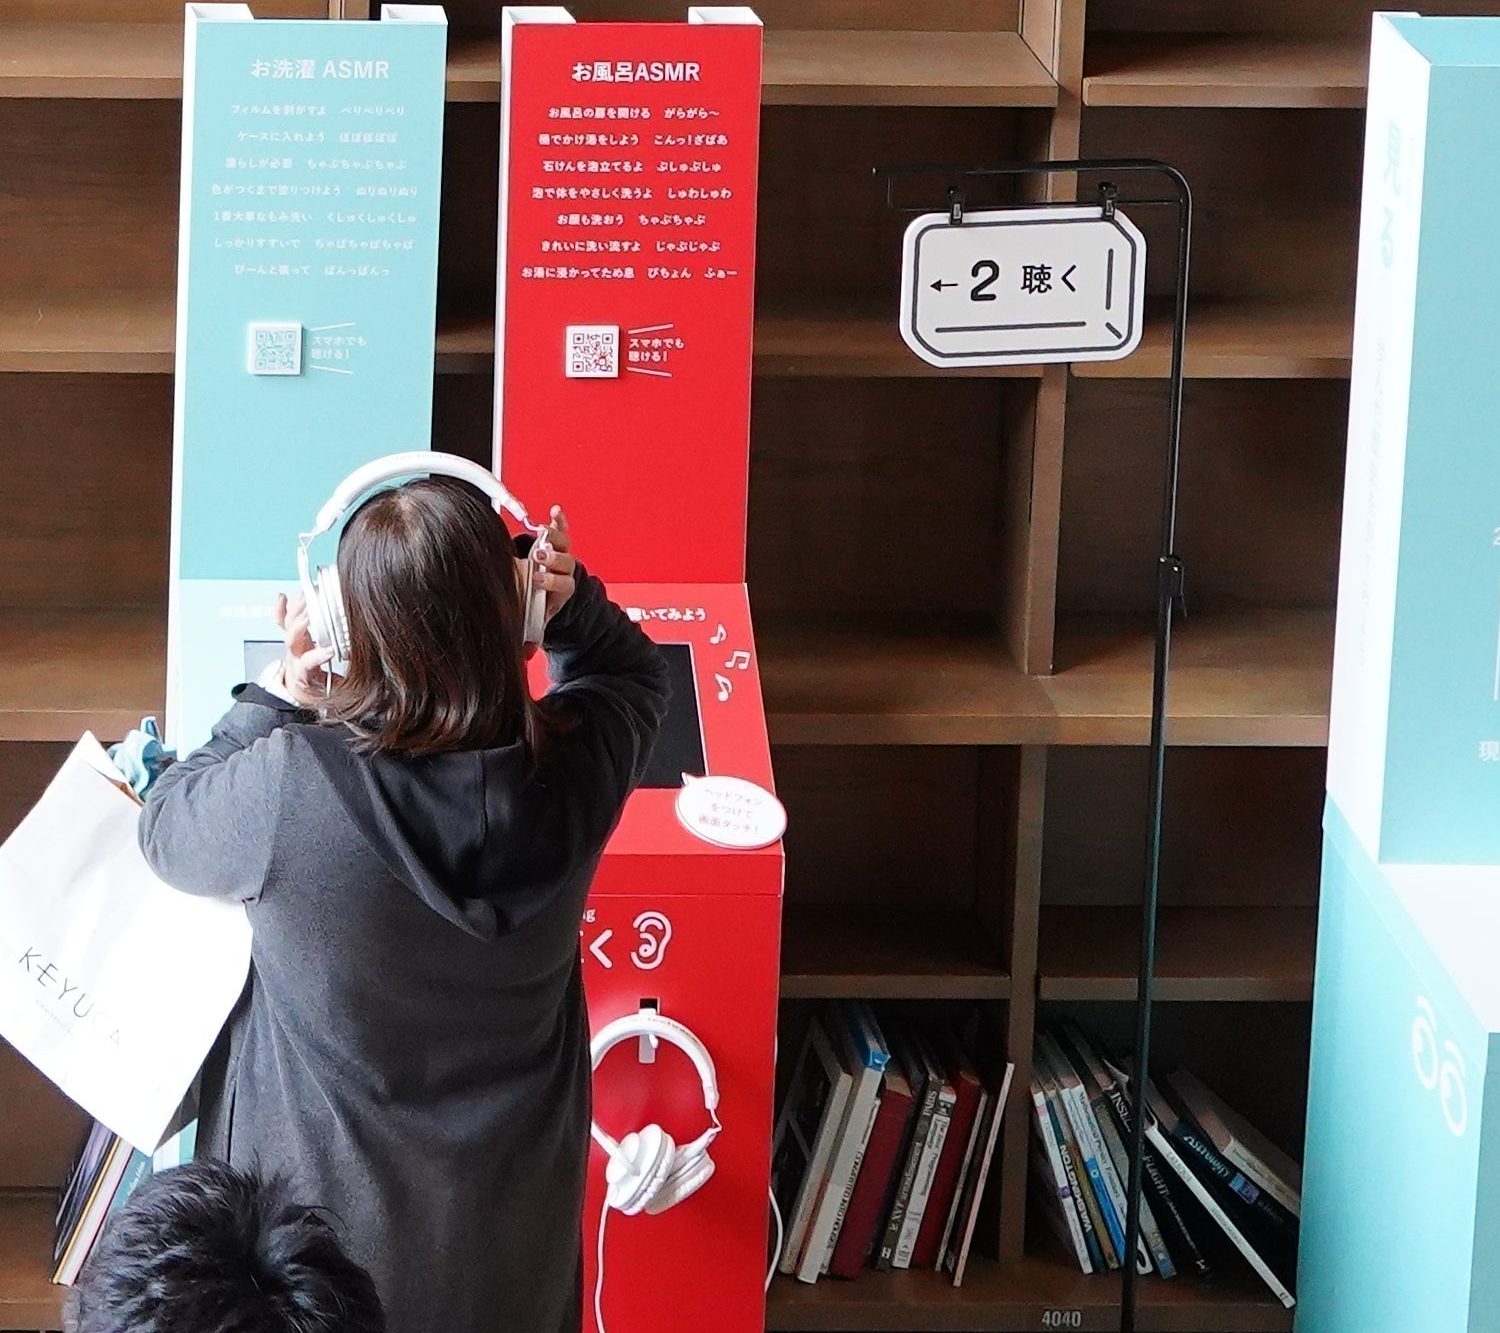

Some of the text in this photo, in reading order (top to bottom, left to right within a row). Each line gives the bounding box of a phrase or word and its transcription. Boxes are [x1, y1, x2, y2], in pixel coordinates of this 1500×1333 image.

[251, 57, 389, 80] お洗濯 ASMR
[571, 60, 700, 84] お風呂ASMR
[970, 260, 1077, 301] 2 聴く
[1041, 1310, 1082, 1328] 4040
